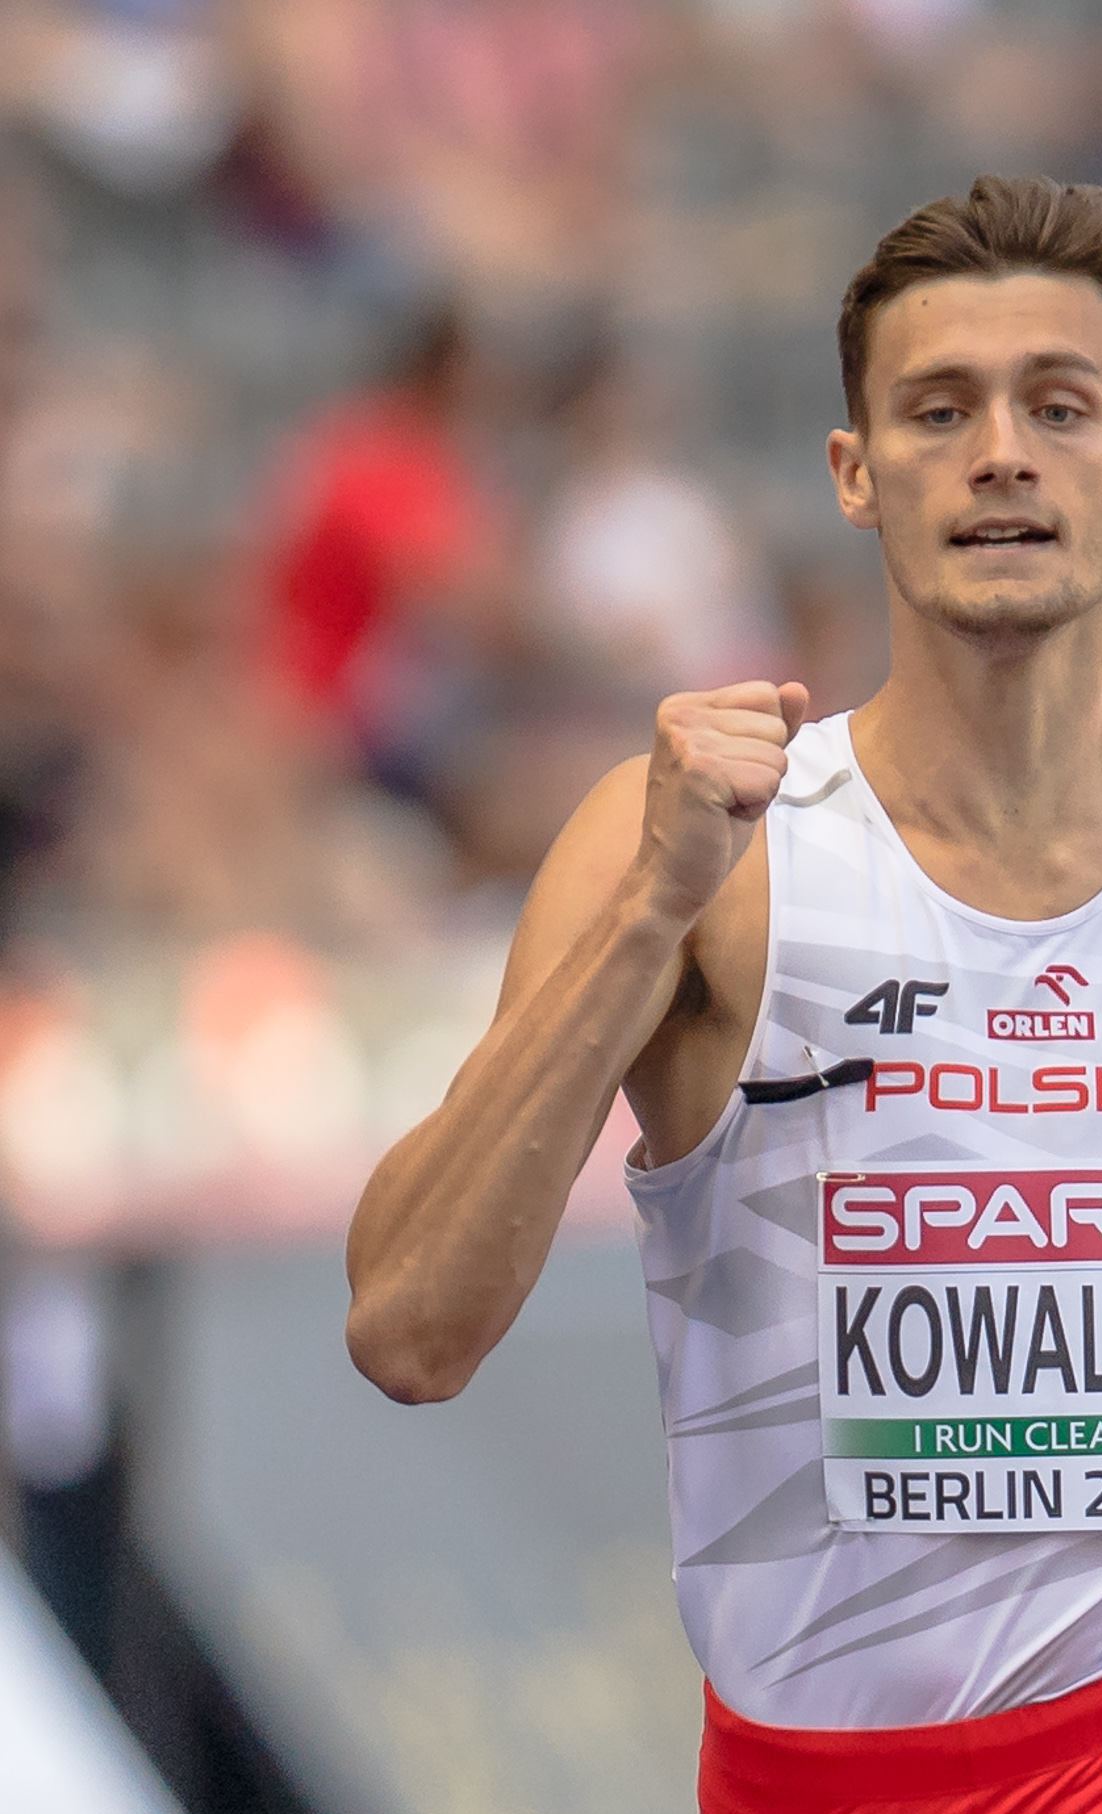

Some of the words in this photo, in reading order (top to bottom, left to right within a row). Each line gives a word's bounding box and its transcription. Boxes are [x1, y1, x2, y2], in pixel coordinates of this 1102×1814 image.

[844, 979, 949, 1034] 4F
[992, 1013, 1088, 1037] ORLEN
[914, 1424, 922, 1453] I
[936, 1423, 1012, 1452] RUN
[864, 1469, 1062, 1521] BERLIN
